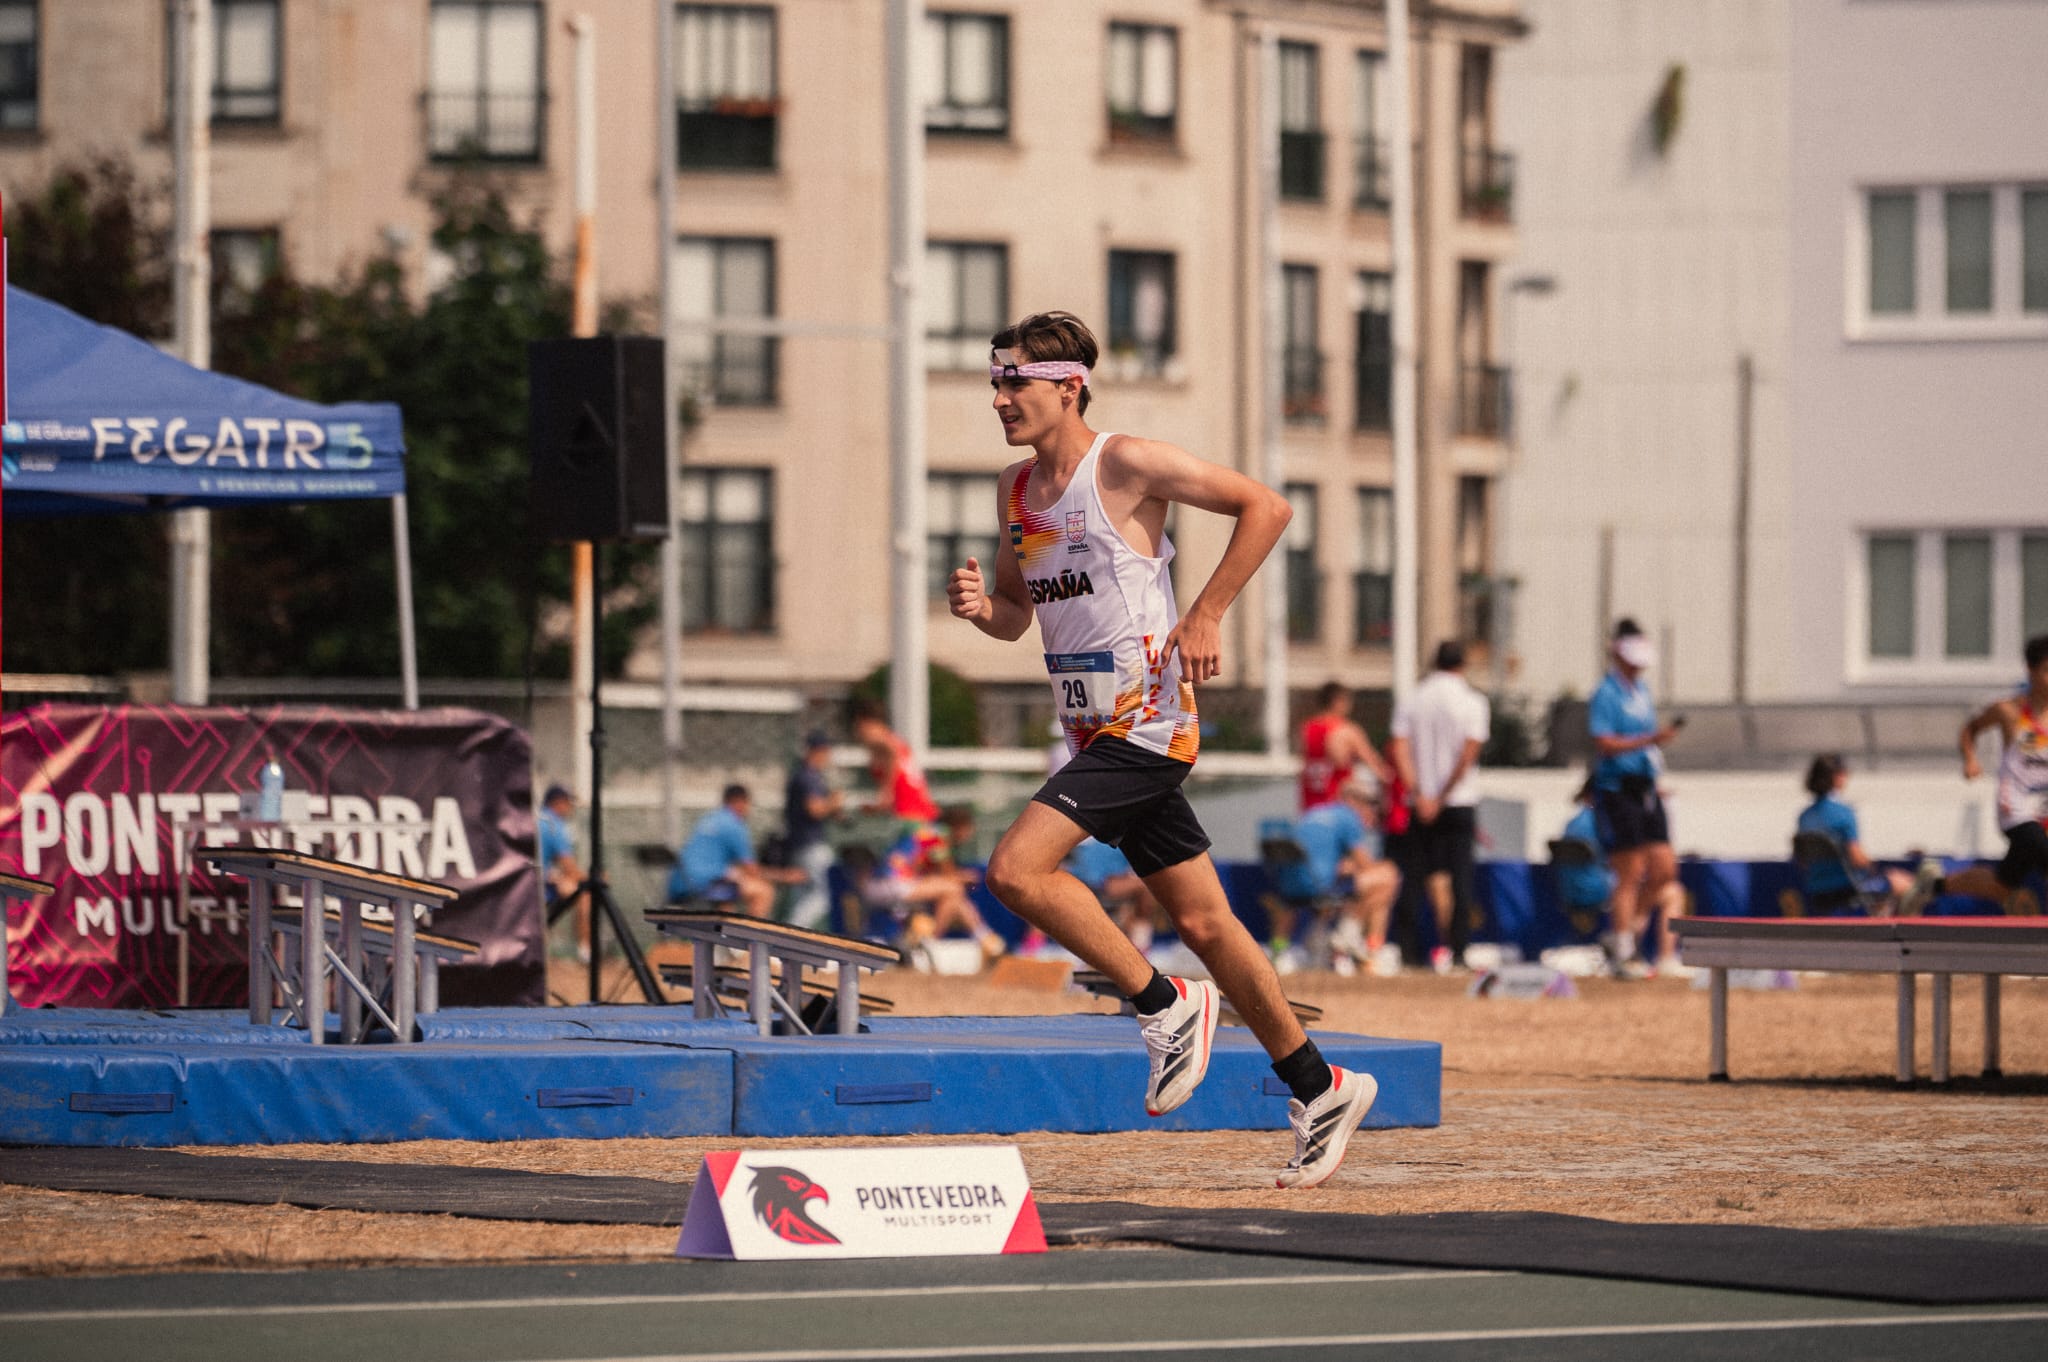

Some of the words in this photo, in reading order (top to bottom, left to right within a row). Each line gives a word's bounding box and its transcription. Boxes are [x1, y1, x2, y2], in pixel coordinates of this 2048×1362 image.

[1062, 679, 1088, 709] 29
[20, 791, 476, 880] PONTEEDRA
[856, 1184, 1006, 1210] PONTEVEDRA
[884, 1213, 992, 1228] MULTISPORT
